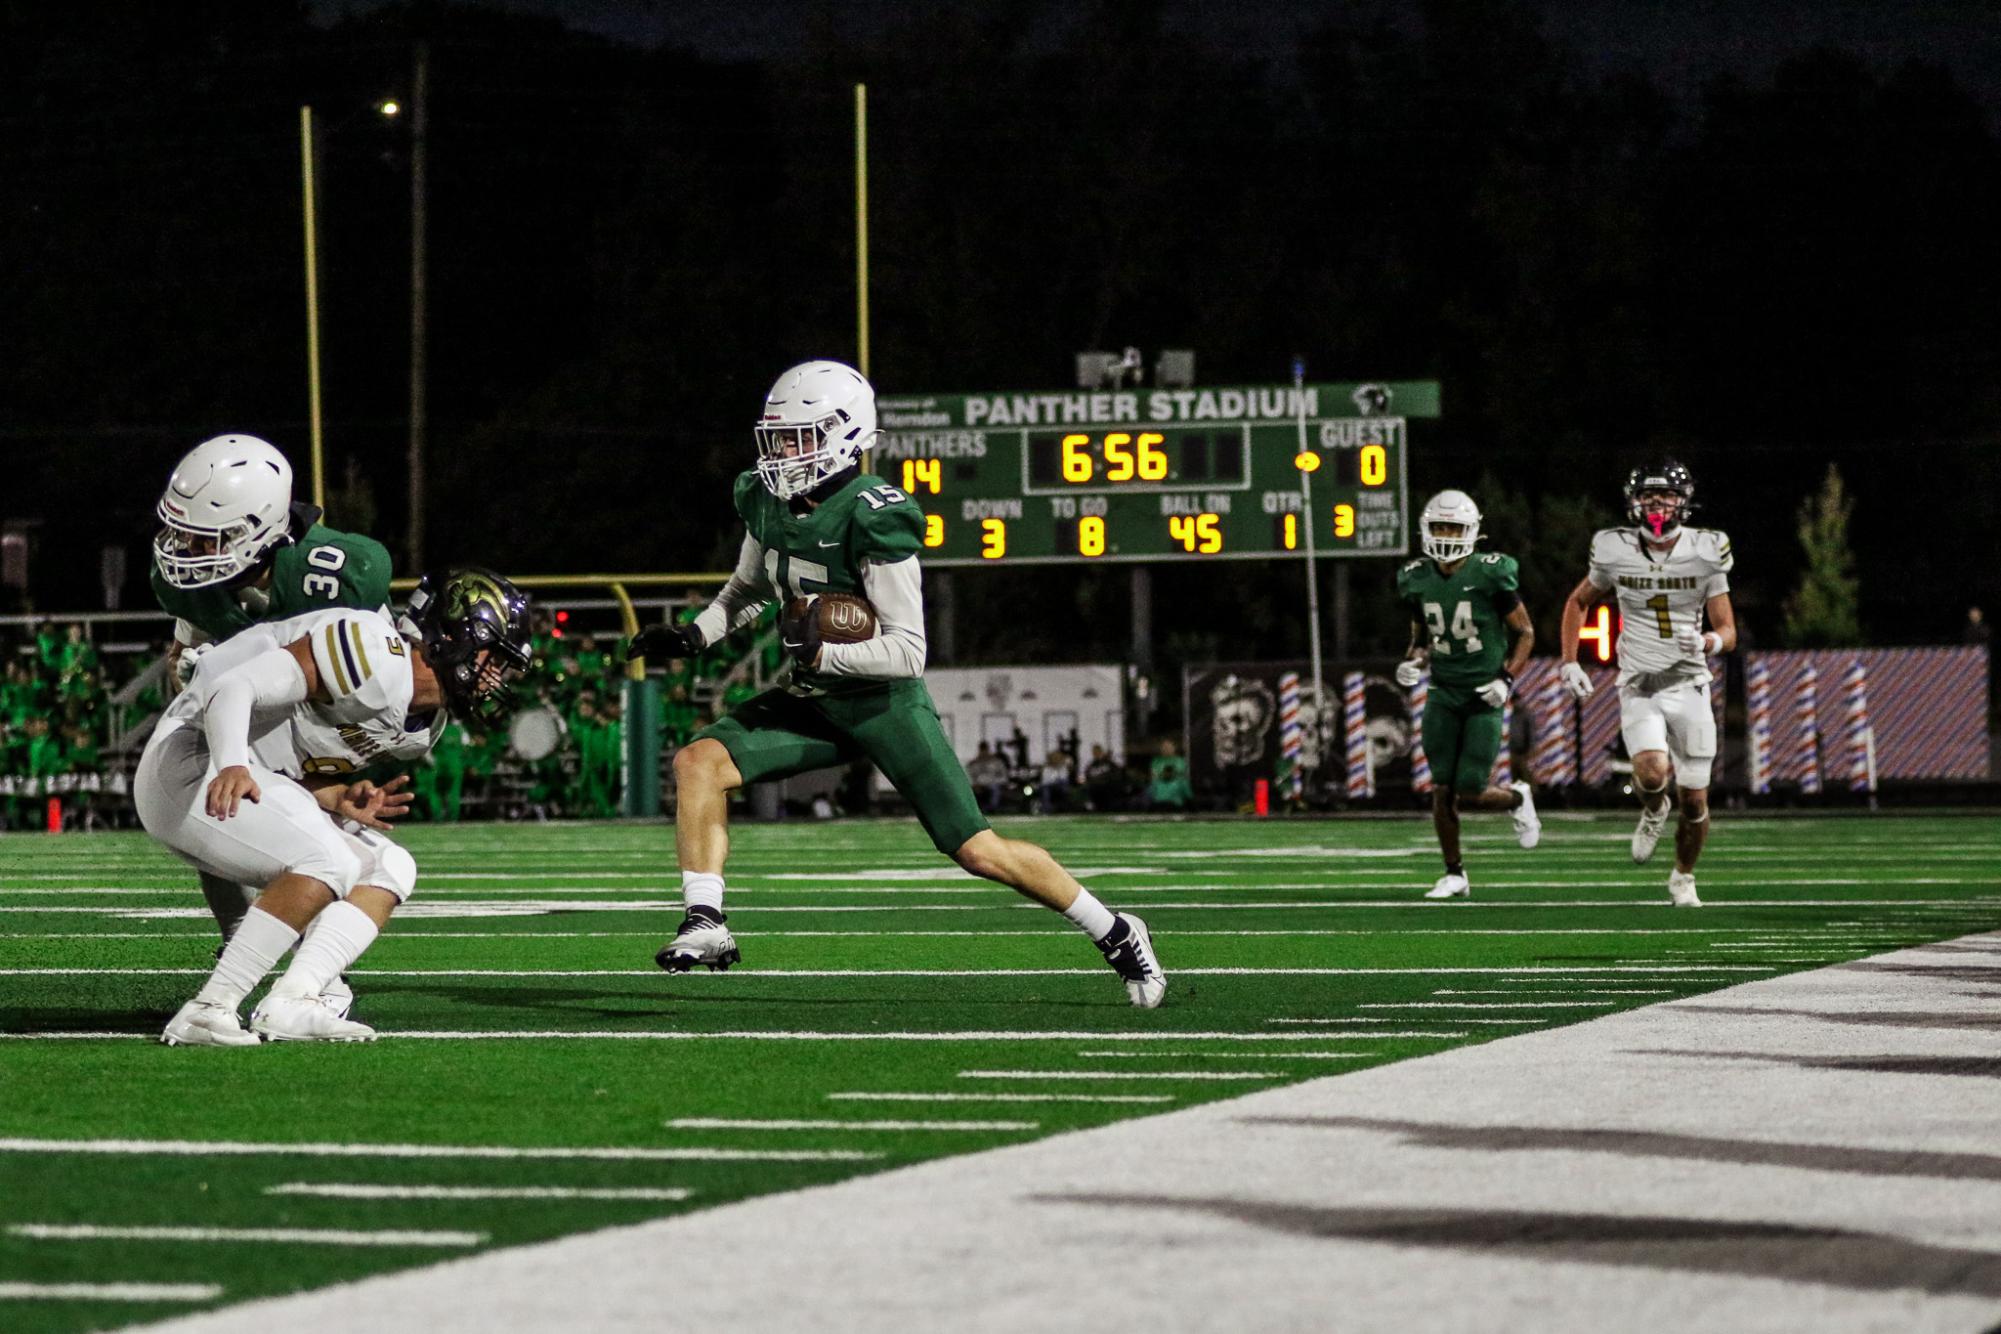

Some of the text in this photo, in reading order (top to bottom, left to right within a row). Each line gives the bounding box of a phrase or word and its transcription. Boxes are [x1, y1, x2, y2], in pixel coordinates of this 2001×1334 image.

[965, 393, 1138, 425] PANTHER
[1149, 389, 1318, 420] STADIUM
[874, 432, 987, 458] PANTHERS
[1320, 421, 1396, 448] GUEST
[903, 459, 941, 494] 14
[1360, 445, 1386, 486] 0
[856, 484, 906, 510] 15
[962, 499, 1023, 519] DOWN
[1052, 497, 1108, 517] TO GO
[1160, 495, 1200, 515] BALL
[924, 515, 944, 547] 3
[1079, 516, 1105, 557] 8
[1169, 513, 1222, 554] 45
[1284, 514, 1296, 549] 1
[1334, 504, 1354, 537] 3
[981, 519, 1005, 559] 3
[303, 546, 346, 600] 30
[1423, 601, 1483, 655] 24
[1647, 594, 1673, 639] 1
